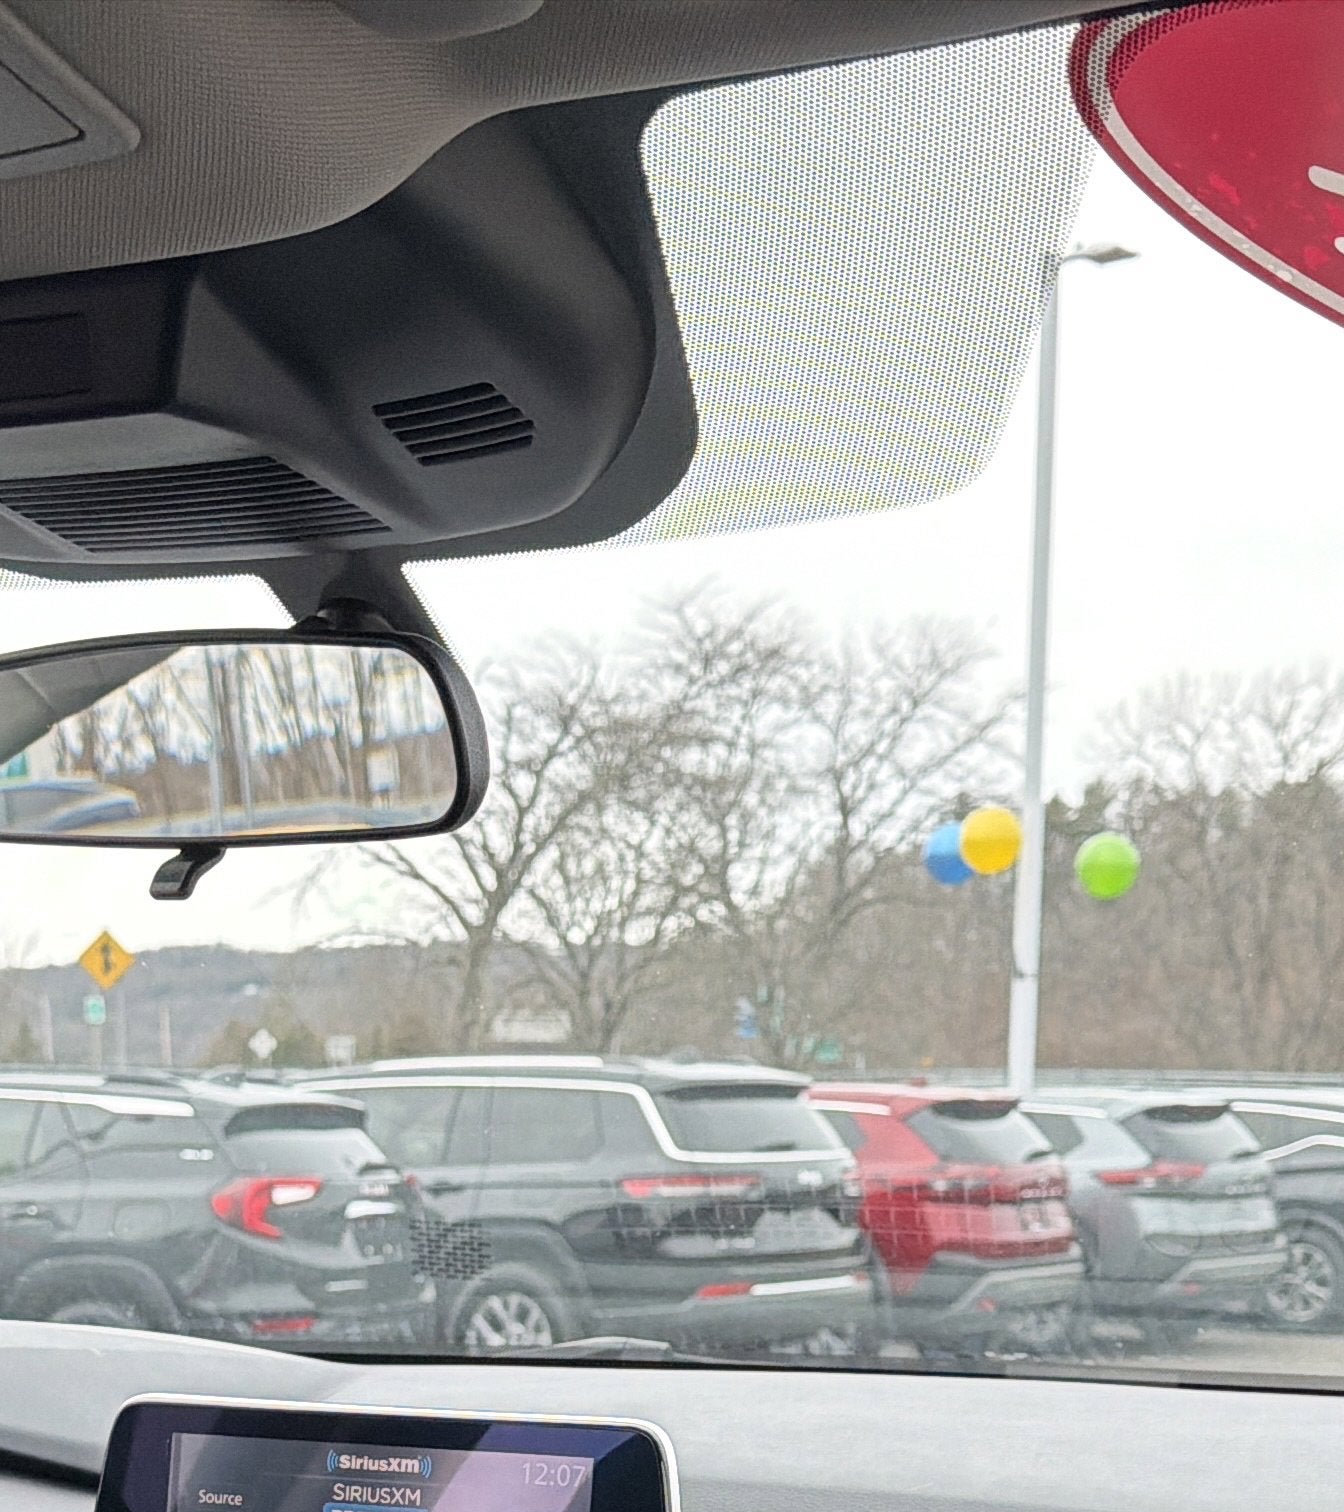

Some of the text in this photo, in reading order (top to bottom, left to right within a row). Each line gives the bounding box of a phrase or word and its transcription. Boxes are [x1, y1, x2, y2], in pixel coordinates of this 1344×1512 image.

[522, 1463, 587, 1488] 12:07
[198, 1489, 243, 1506] Source
[331, 1483, 422, 1506] SIRIUSXM
